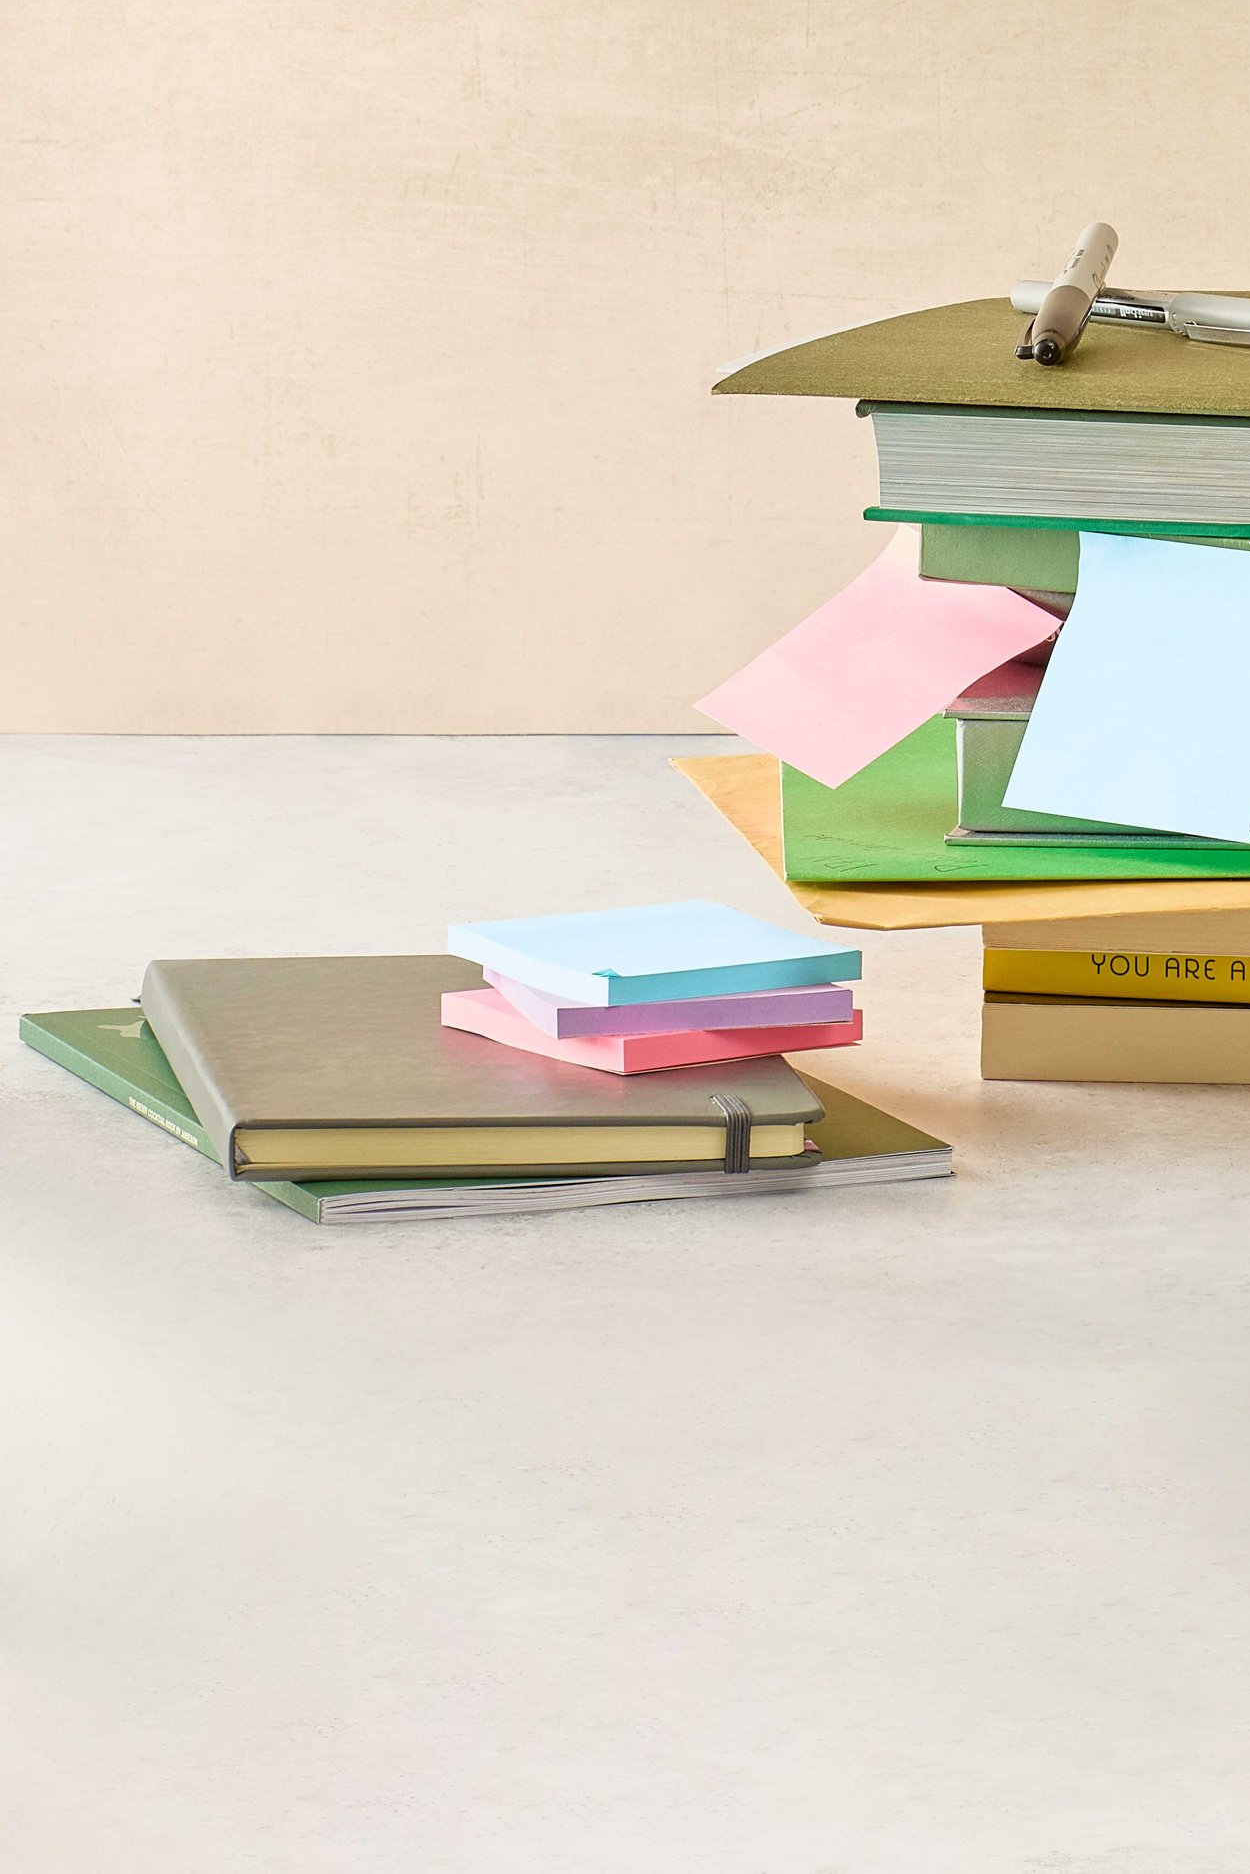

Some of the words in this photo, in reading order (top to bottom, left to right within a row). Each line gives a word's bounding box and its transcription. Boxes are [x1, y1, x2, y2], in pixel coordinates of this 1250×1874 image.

[1091, 954, 1149, 977] YOU
[1165, 957, 1216, 981] ARE
[1230, 960, 1246, 981] A
